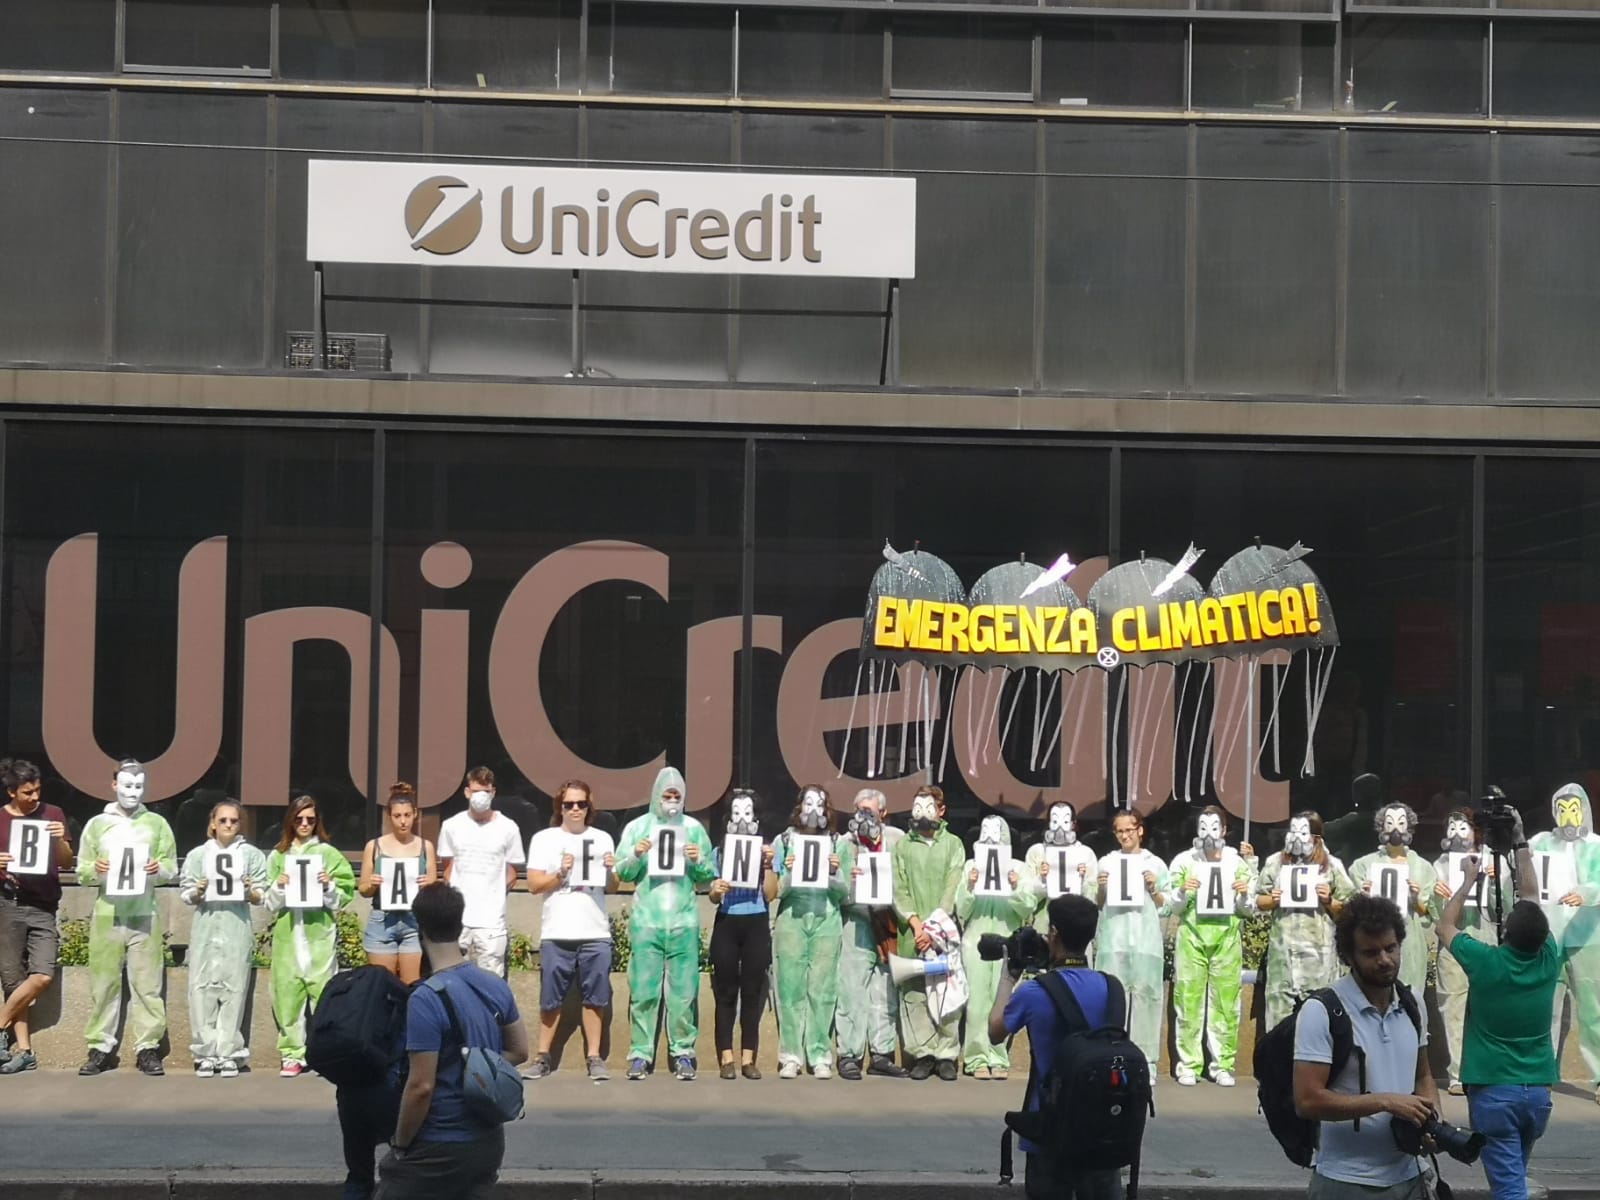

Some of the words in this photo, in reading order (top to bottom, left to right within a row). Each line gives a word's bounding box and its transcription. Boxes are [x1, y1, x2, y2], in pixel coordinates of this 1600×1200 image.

[499, 185, 822, 263] UniCredit
[874, 597, 1099, 655] EMERGENZA
[1111, 584, 1322, 653] CLIMATICA!
